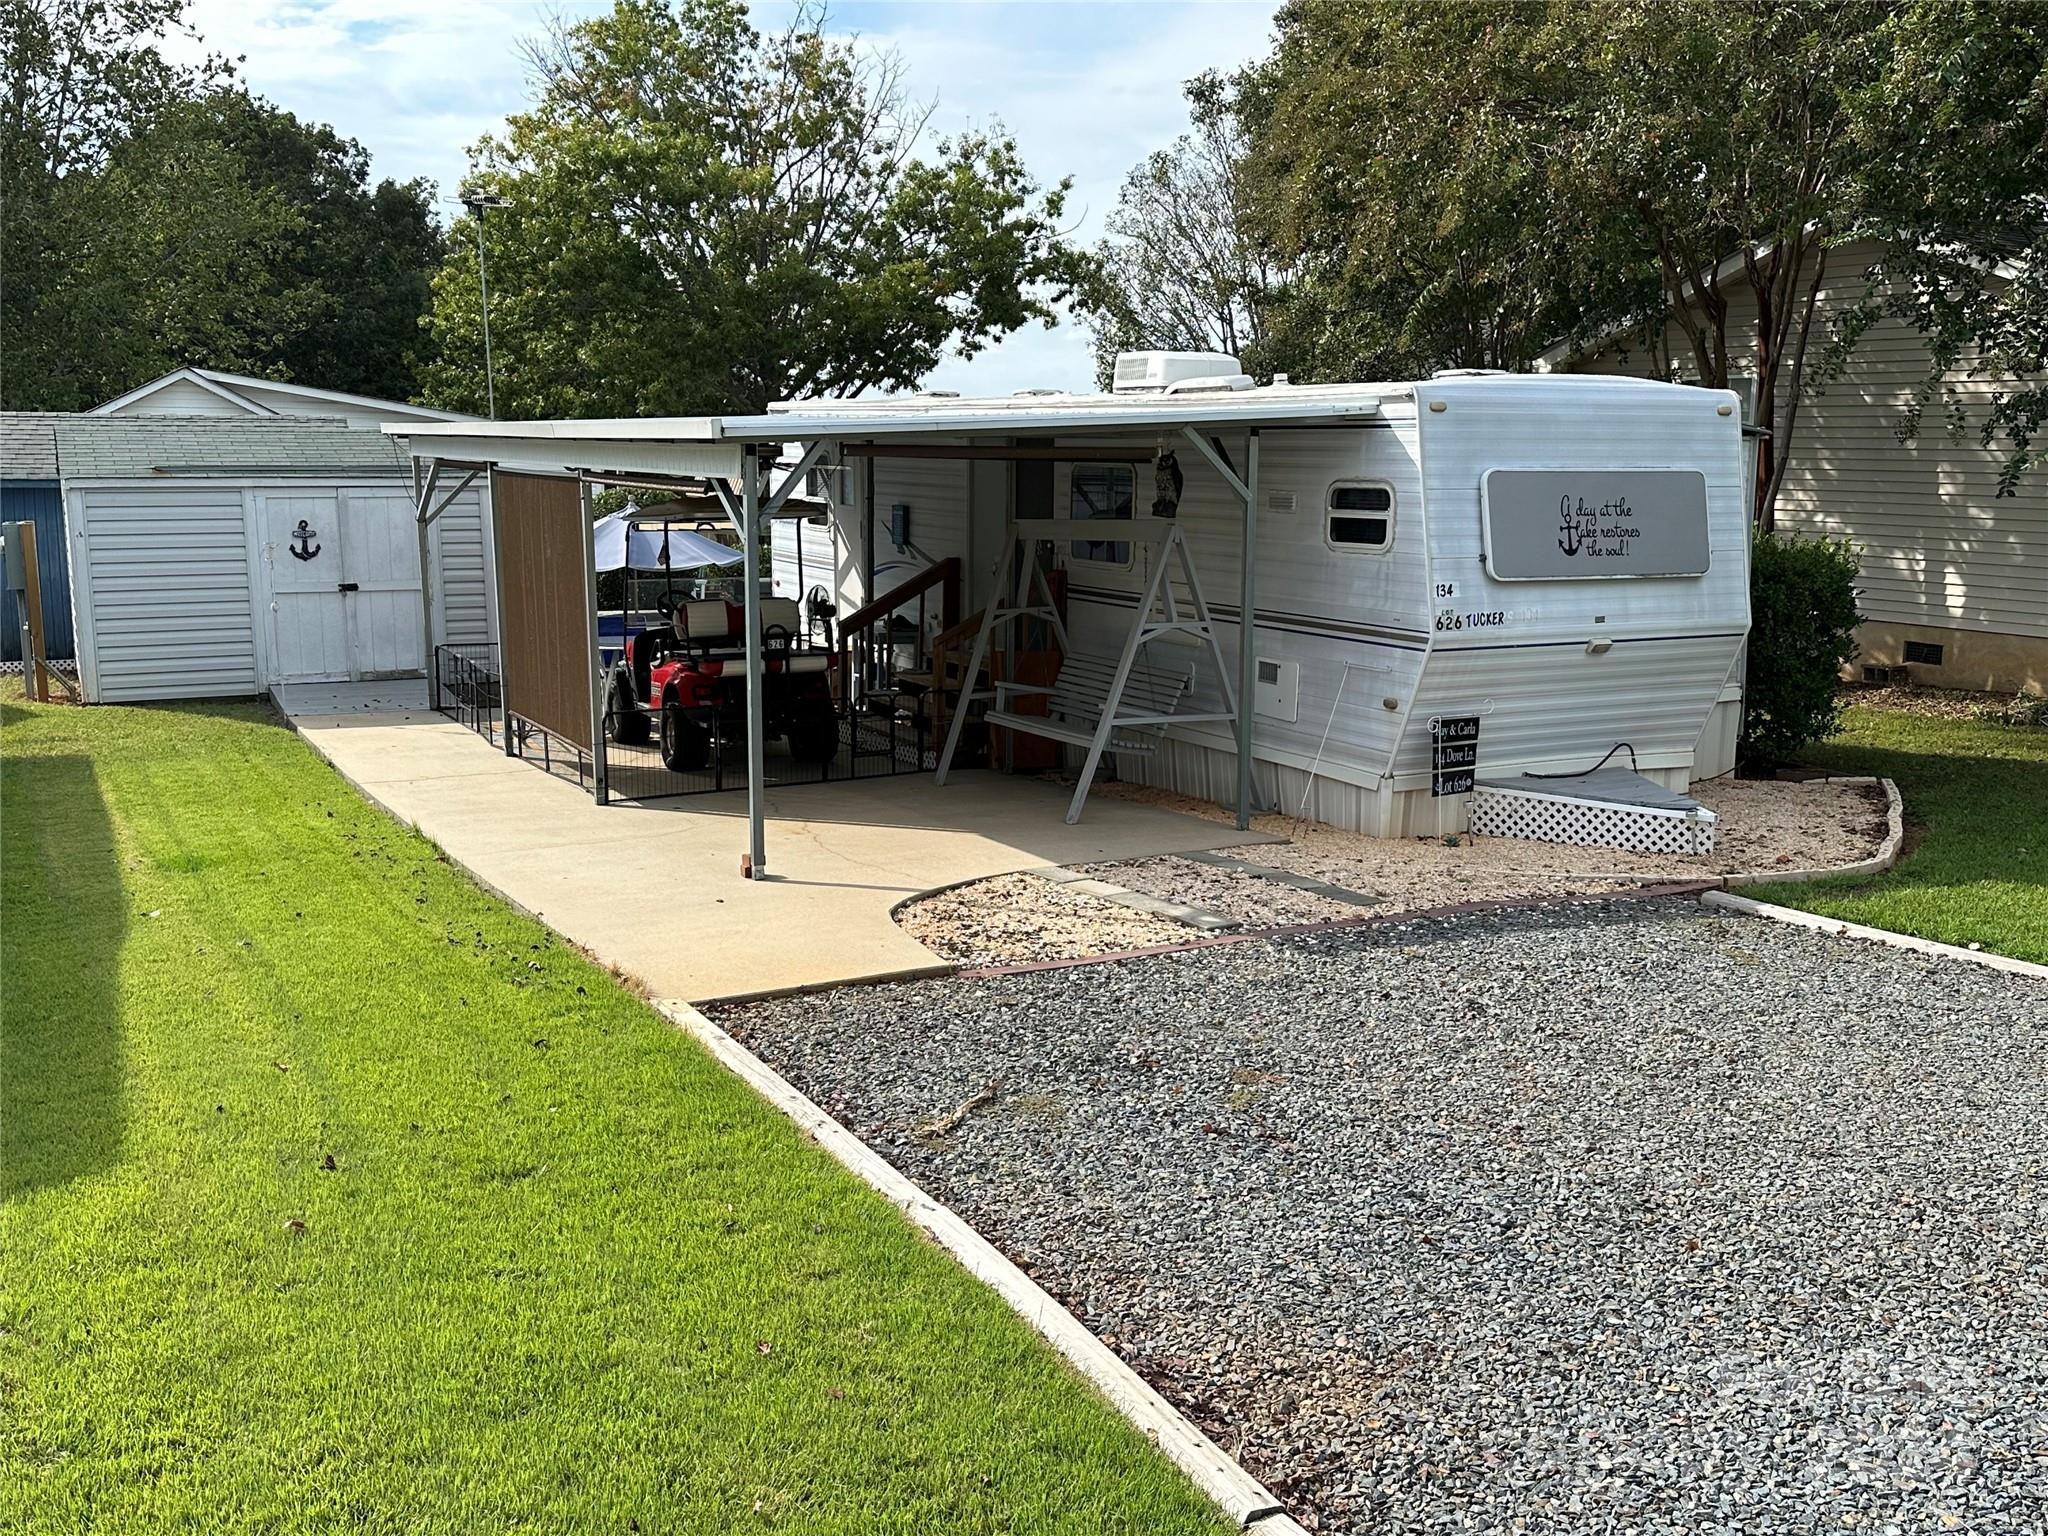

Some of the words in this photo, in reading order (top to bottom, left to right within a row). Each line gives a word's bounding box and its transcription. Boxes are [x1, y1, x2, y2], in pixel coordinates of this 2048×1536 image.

[1576, 497, 1597, 526] day
[1600, 499, 1613, 517] at
[1613, 497, 1632, 517] the
[1576, 518, 1599, 539] lake
[1600, 521, 1641, 538] restores
[1586, 539, 1603, 557] the
[1605, 539, 1630, 557] soul!
[1436, 584, 1453, 598] 134
[1436, 616, 1462, 631] 626
[1466, 611, 1504, 628] TUCKER
[1441, 609, 1454, 617] LOT
[768, 639, 784, 649] 626
[1449, 724, 1456, 736] &
[1458, 722, 1476, 736] Carla
[1446, 748, 1463, 763] Dove
[1440, 778, 1452, 794] Lot
[1453, 775, 1466, 792] 626
